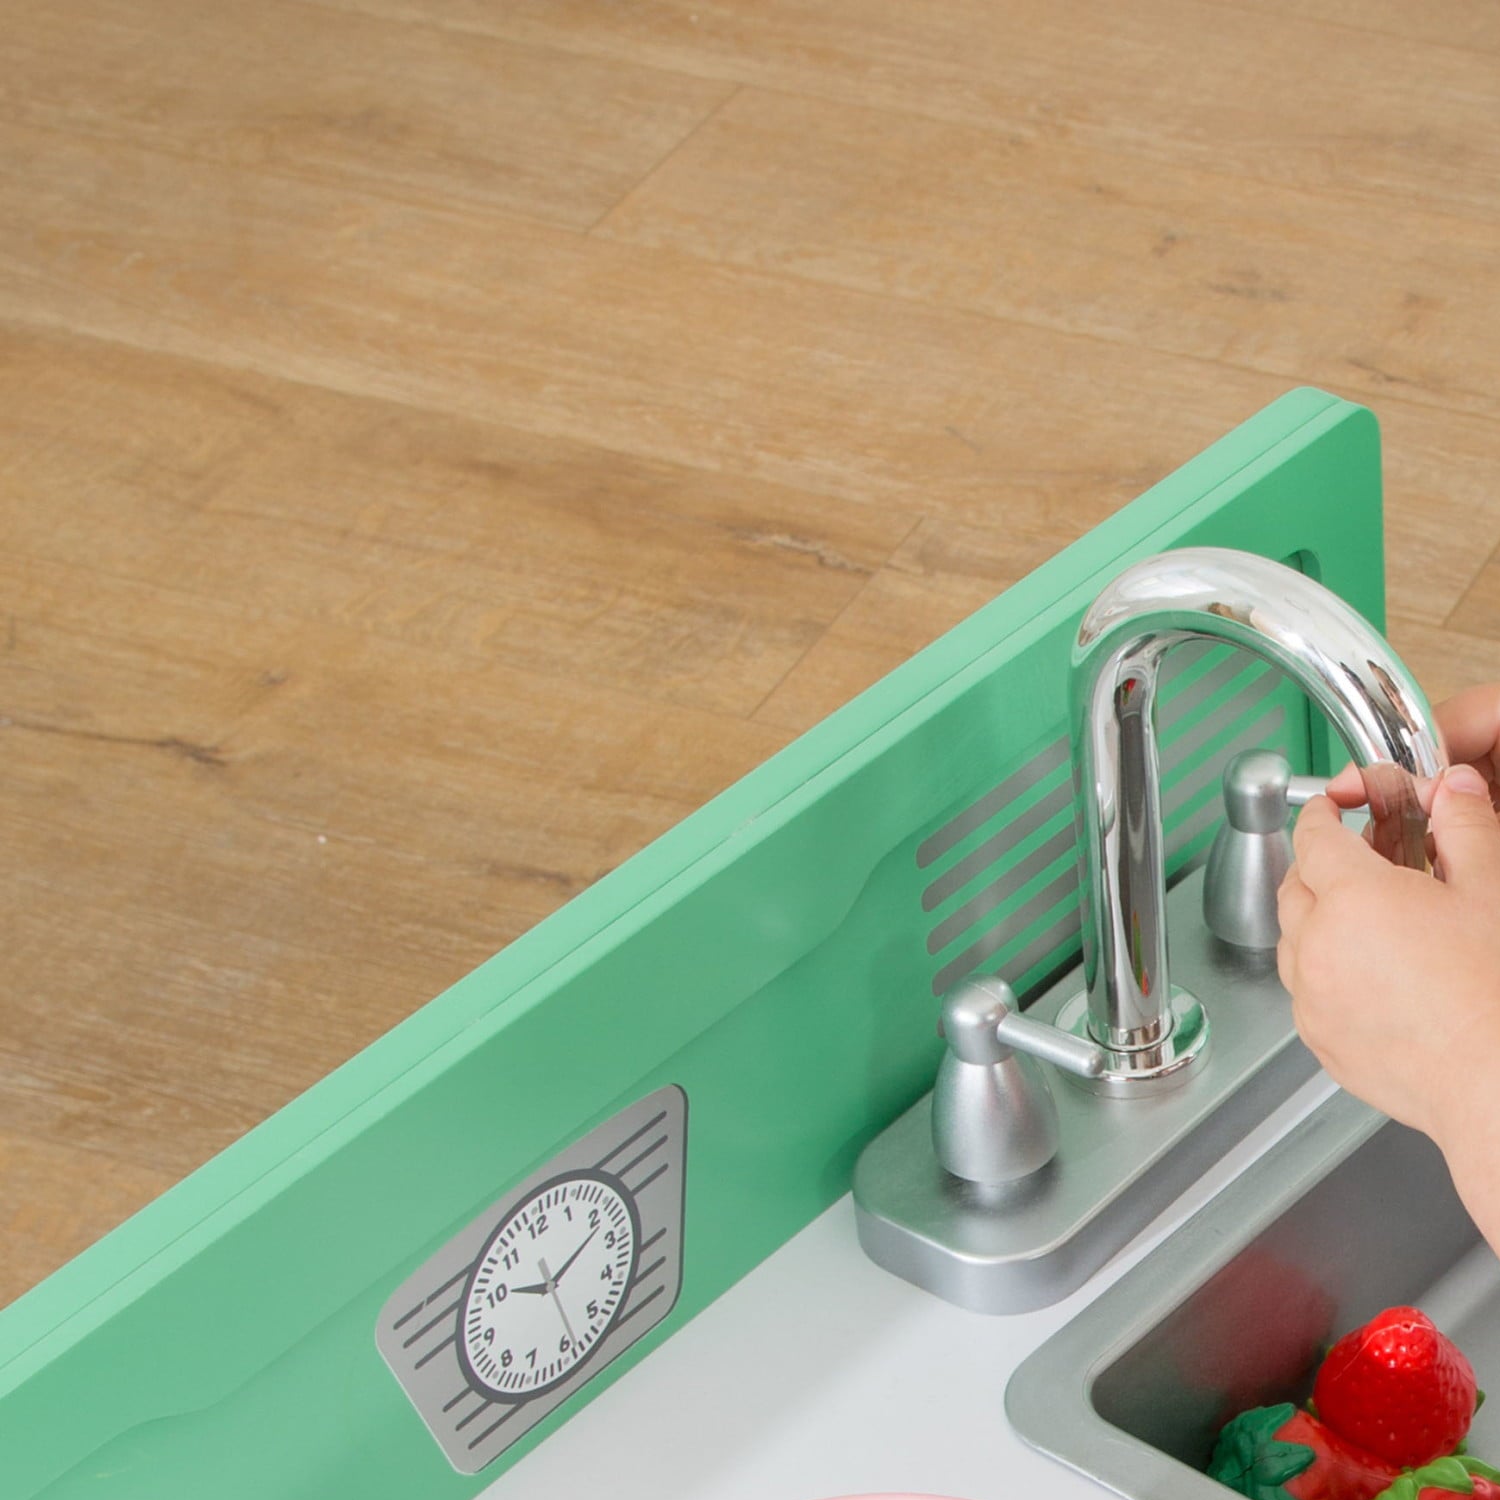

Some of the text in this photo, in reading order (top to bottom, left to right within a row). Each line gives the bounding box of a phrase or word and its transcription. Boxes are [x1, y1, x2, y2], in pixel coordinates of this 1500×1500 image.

[564, 1206, 572, 1221] 1
[588, 1210, 600, 1229] 2
[528, 1214, 549, 1240] 12
[605, 1231, 616, 1249] 3
[502, 1248, 519, 1270] 11
[601, 1265, 612, 1280] 4
[486, 1284, 507, 1308] 10
[586, 1300, 598, 1319] 5
[484, 1328, 494, 1346] 9
[560, 1335, 570, 1352] 6
[501, 1349, 512, 1367] 8
[526, 1348, 537, 1368] 7
